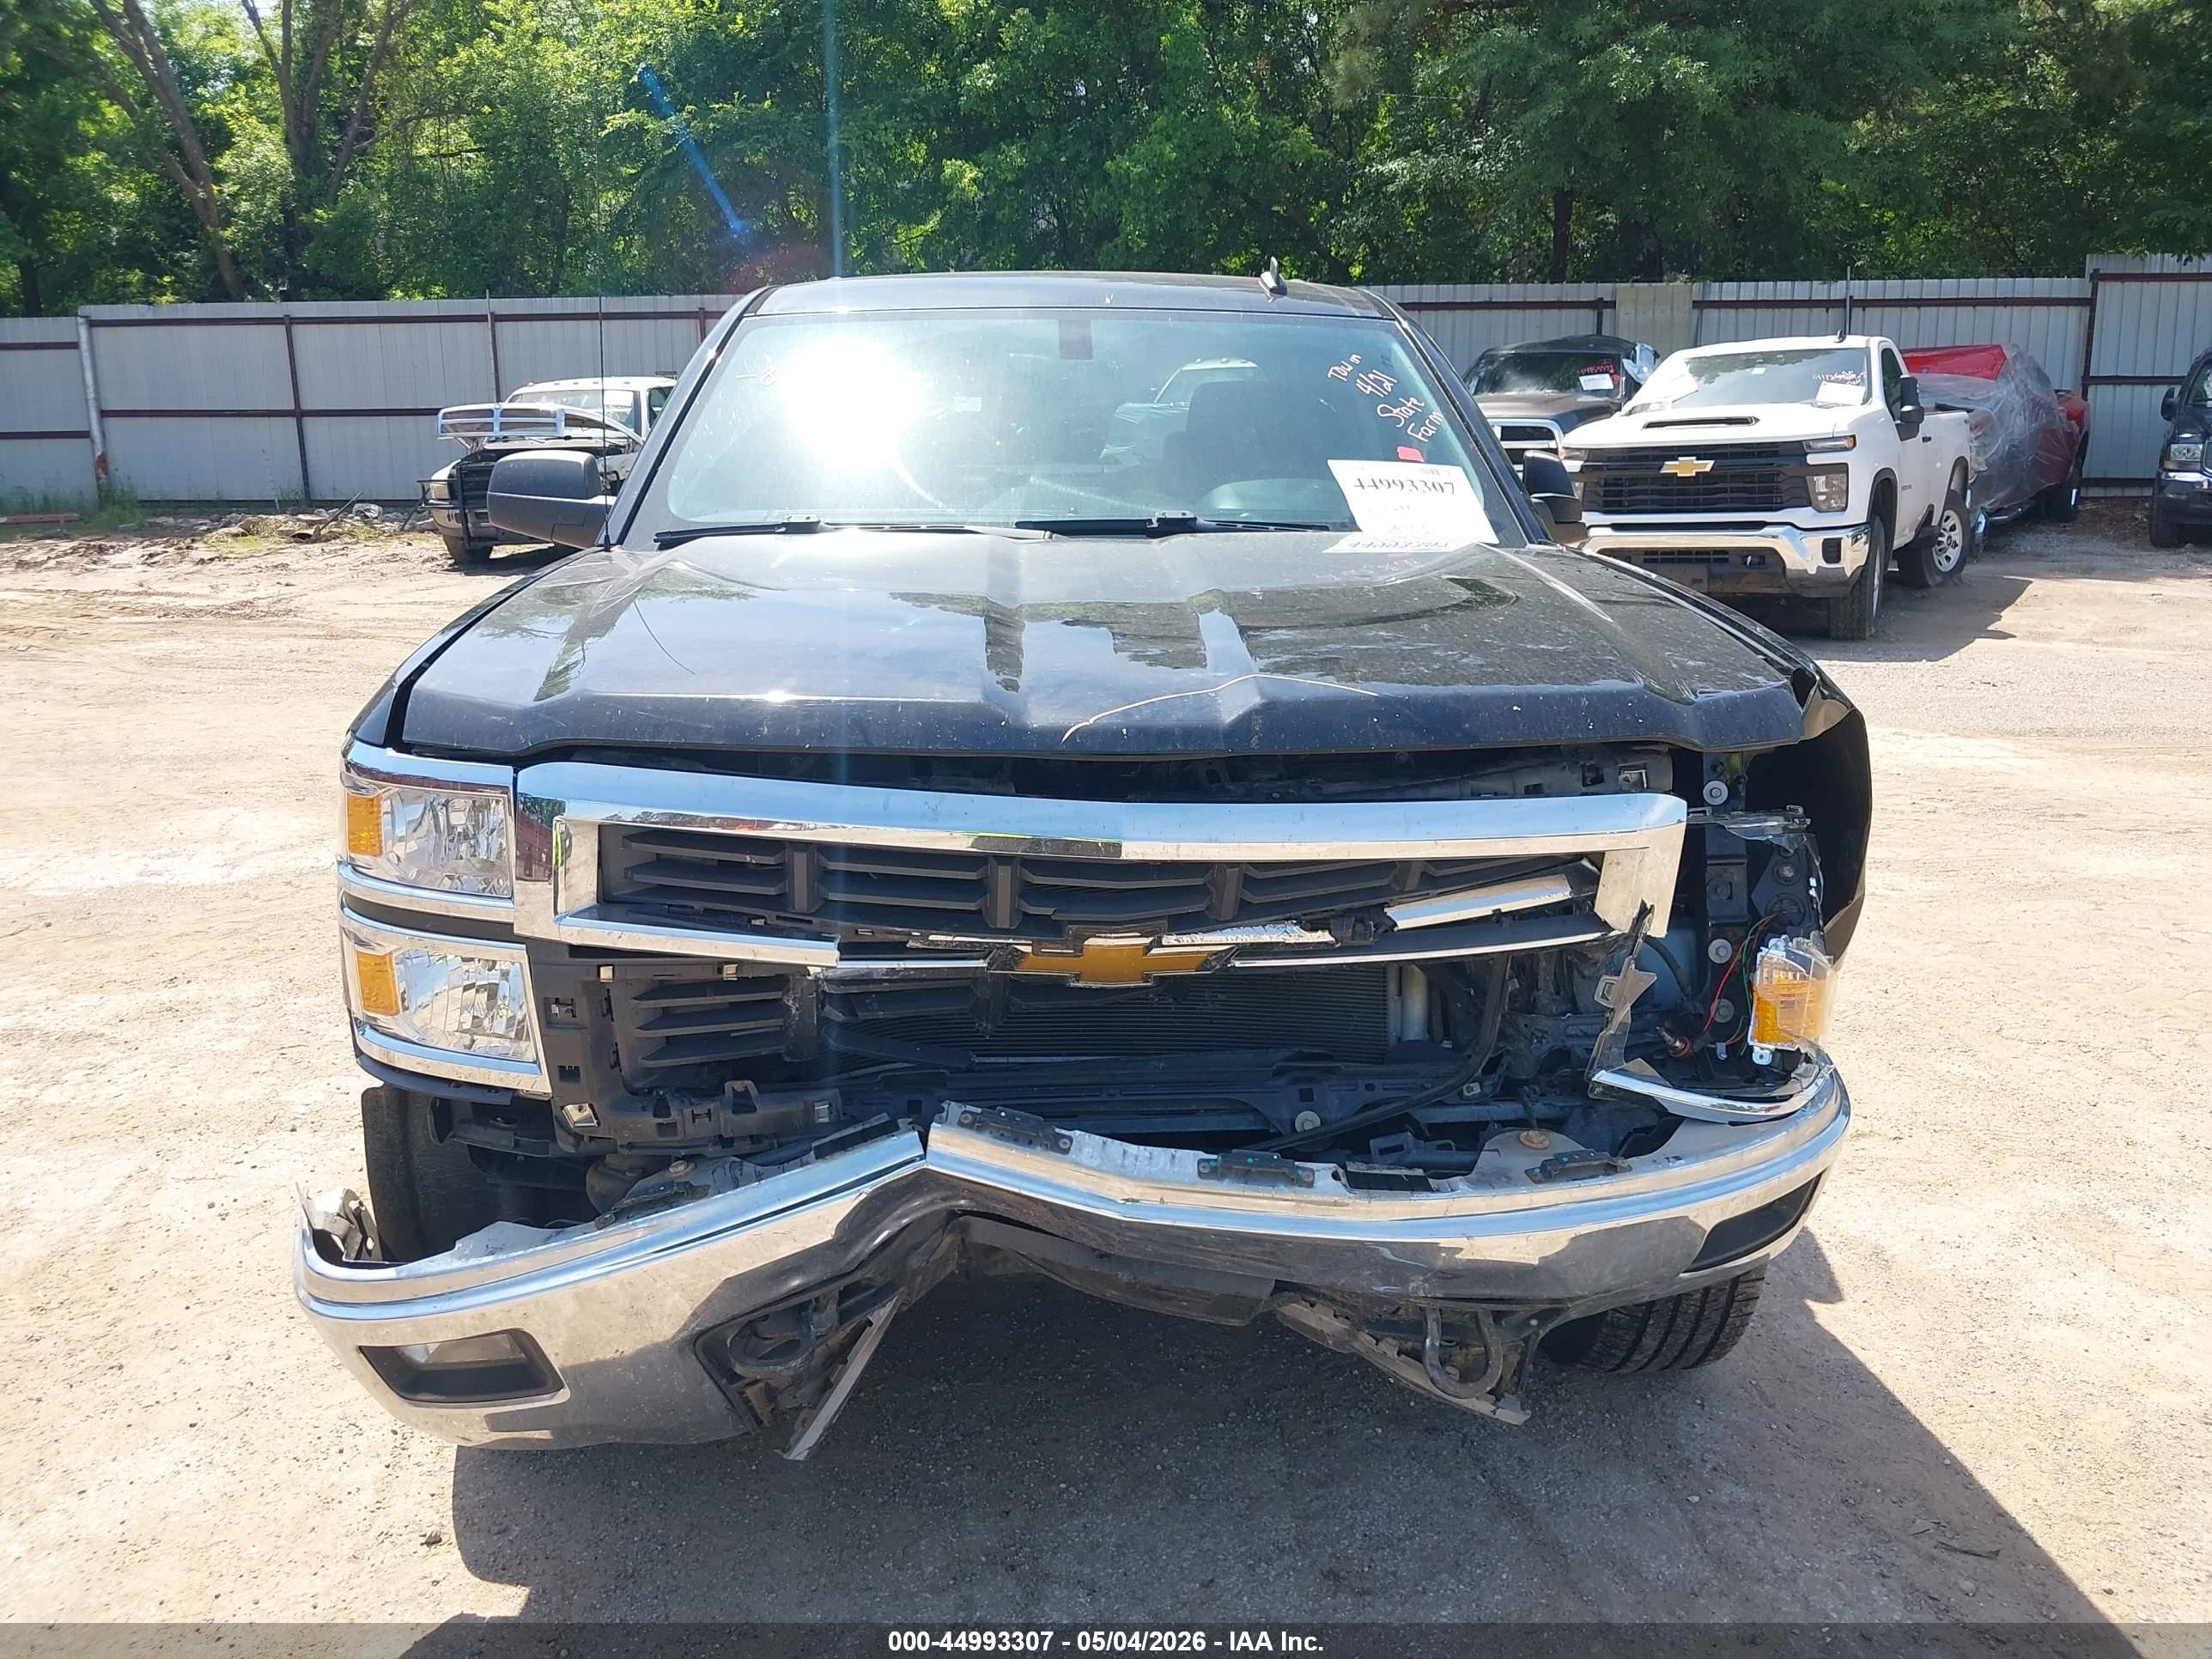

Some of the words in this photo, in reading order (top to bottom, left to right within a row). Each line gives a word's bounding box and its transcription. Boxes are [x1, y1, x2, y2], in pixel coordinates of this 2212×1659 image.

[1355, 369, 1398, 398] 4/21
[1376, 397, 1425, 428] State
[1407, 410, 1444, 442] Farm
[1353, 477, 1455, 495] 44993307
